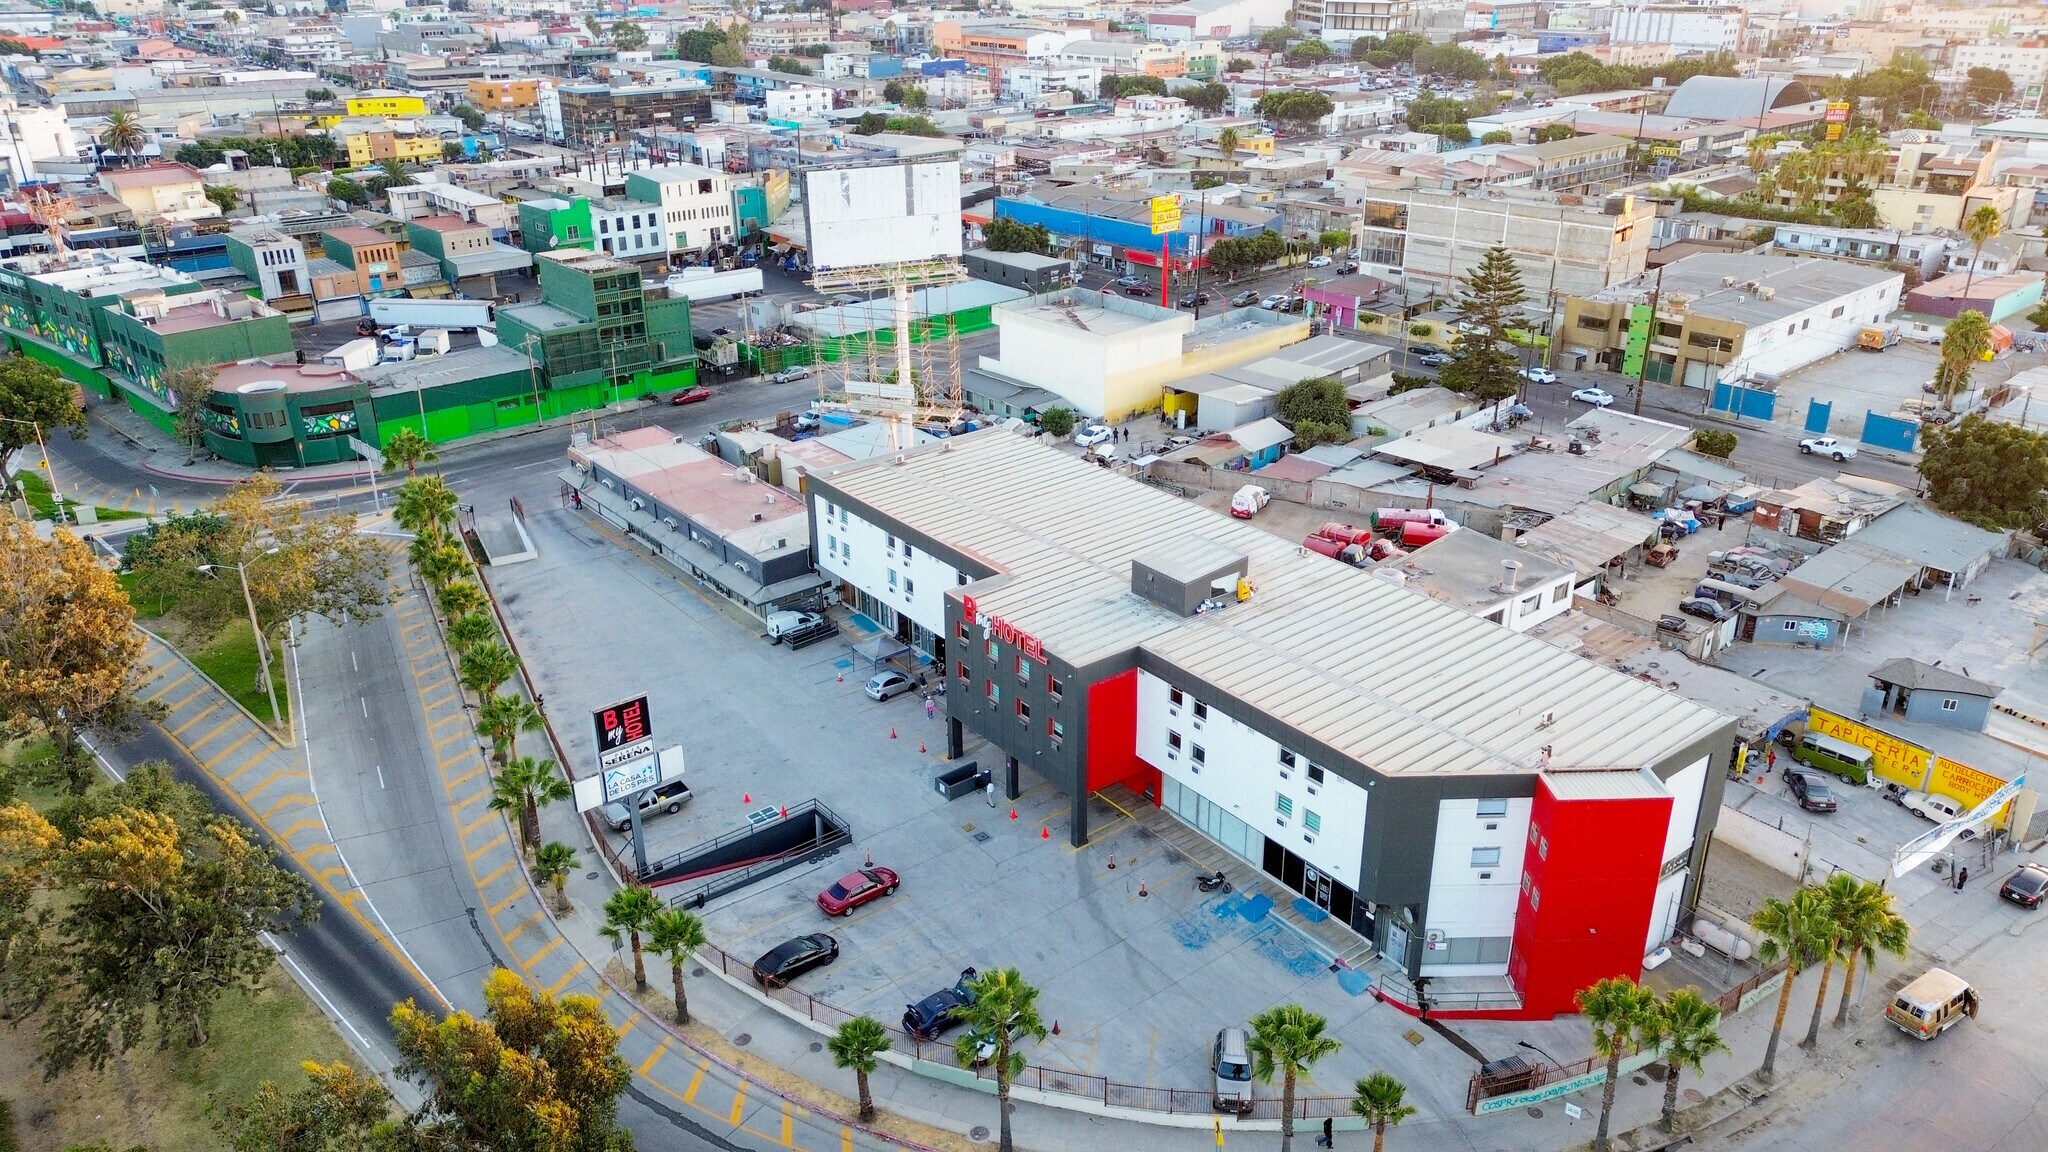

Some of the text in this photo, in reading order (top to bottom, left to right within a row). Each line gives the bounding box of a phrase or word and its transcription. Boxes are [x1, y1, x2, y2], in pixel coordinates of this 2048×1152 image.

[1157, 210, 1179, 222] DEL VALLE
[963, 594, 1049, 665] B my HOTEL
[603, 701, 643, 745] B my HOTEL
[1818, 717, 1920, 767] TAPICERIA
[604, 746, 651, 766] SERENA
[608, 773, 641, 790] LA CASA
[609, 775, 654, 797] DE LOS PIES
[1948, 781, 1970, 793] BODY
